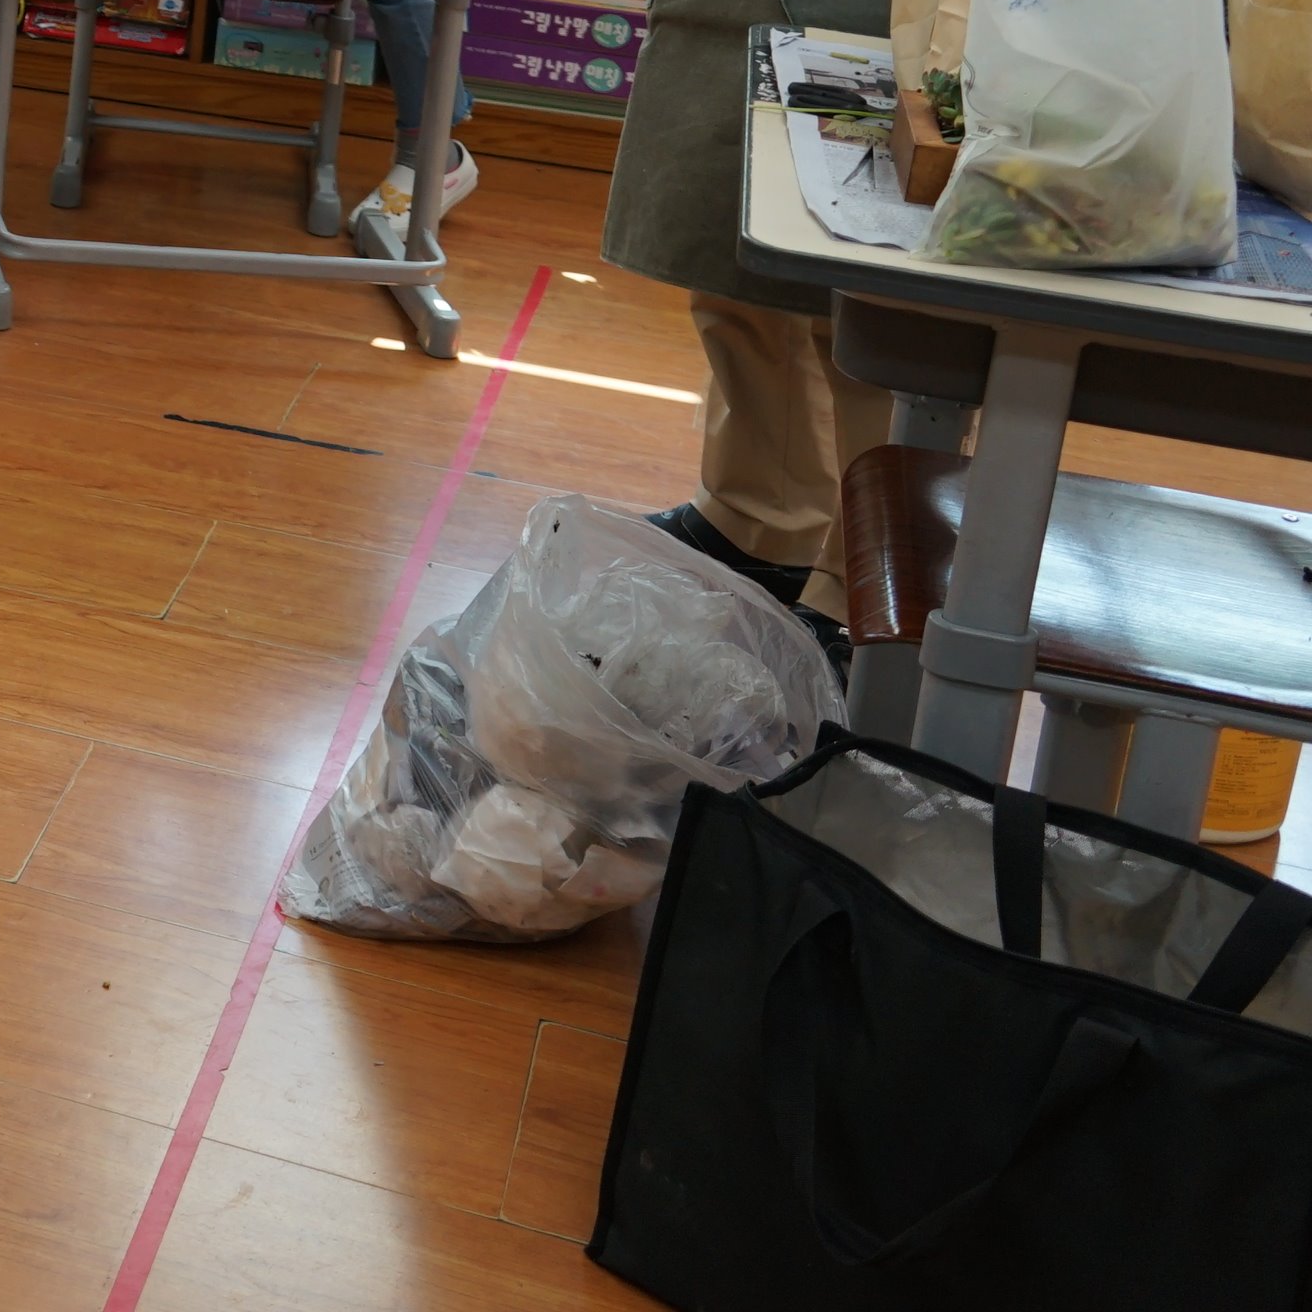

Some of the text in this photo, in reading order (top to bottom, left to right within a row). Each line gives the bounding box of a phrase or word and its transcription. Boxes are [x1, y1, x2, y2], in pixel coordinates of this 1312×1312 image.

[521, 10, 551, 34] 그림
[554, 15, 591, 39] 낱말
[593, 20, 629, 45] 매칭
[512, 54, 543, 78] 그림
[545, 58, 582, 84] 낱말
[585, 64, 619, 88] 매칭
